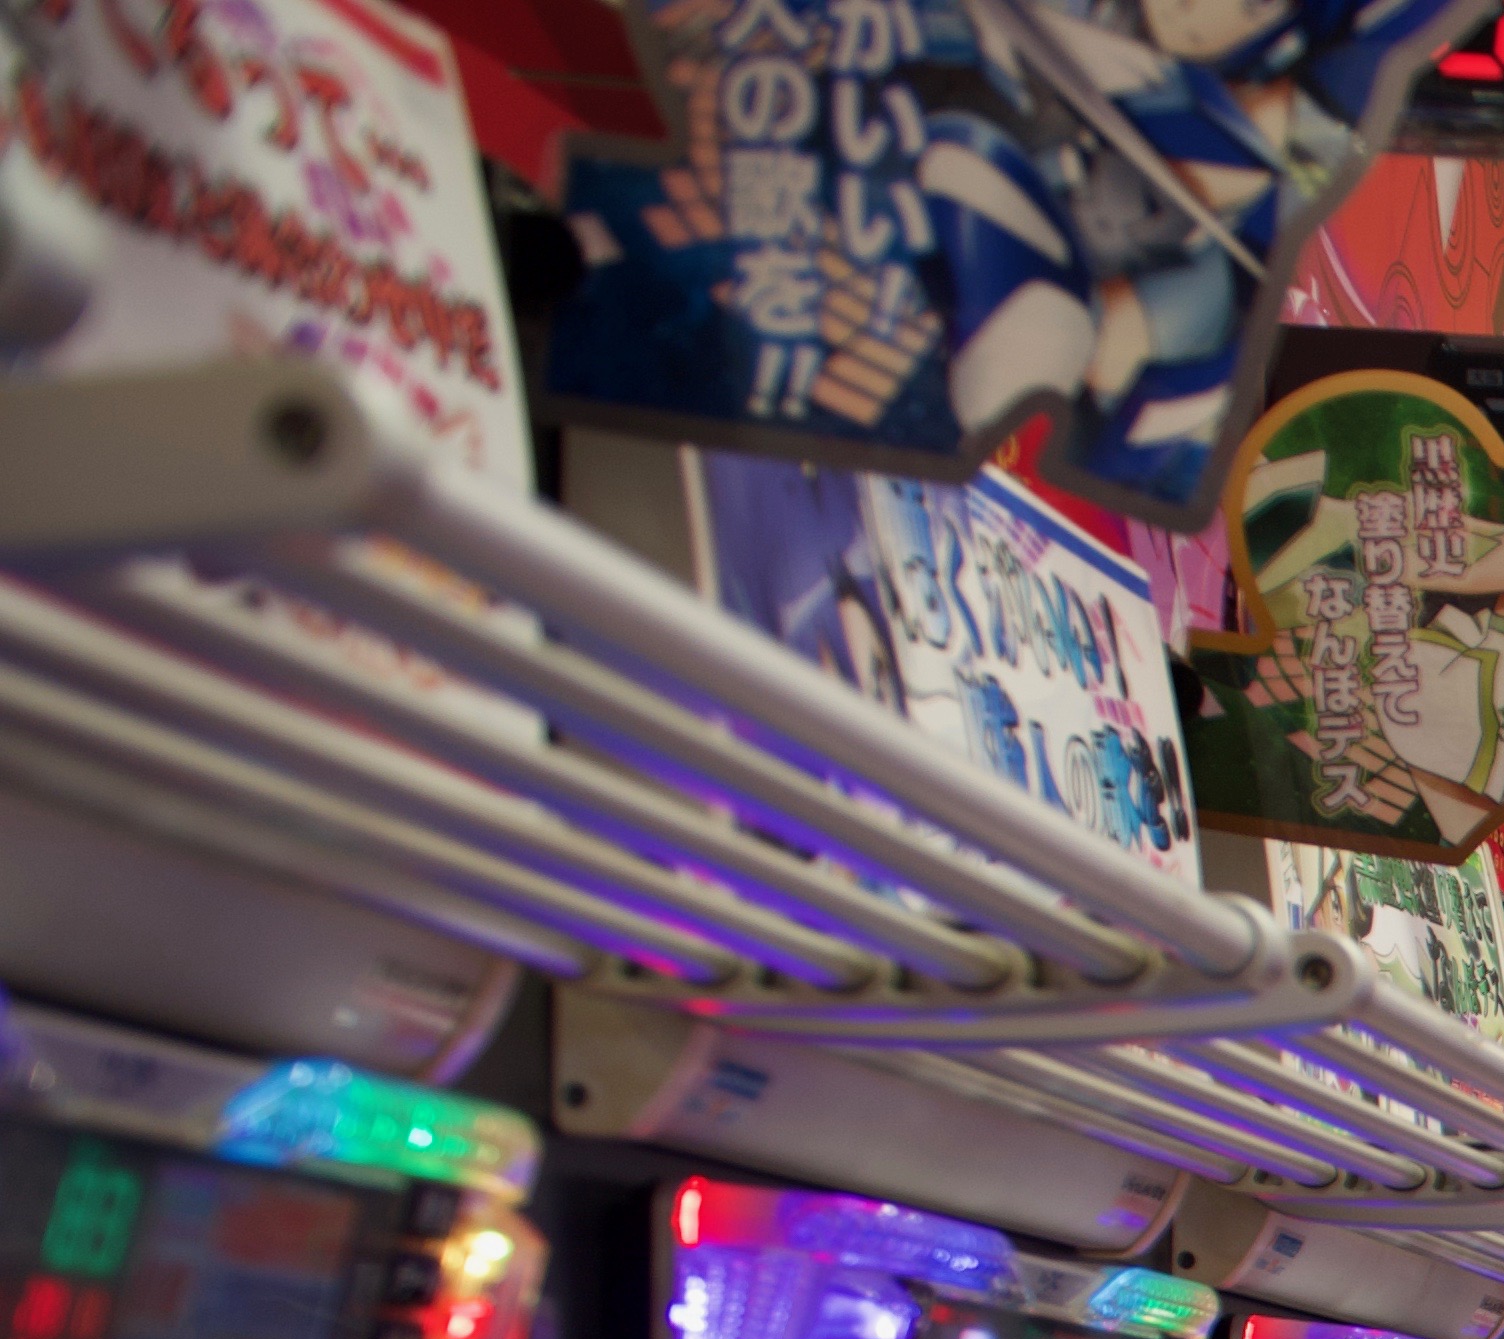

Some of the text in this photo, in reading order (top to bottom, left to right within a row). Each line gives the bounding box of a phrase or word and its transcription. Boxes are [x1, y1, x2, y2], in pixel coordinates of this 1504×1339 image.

[1355, 491, 1421, 726] 塗り替えて
